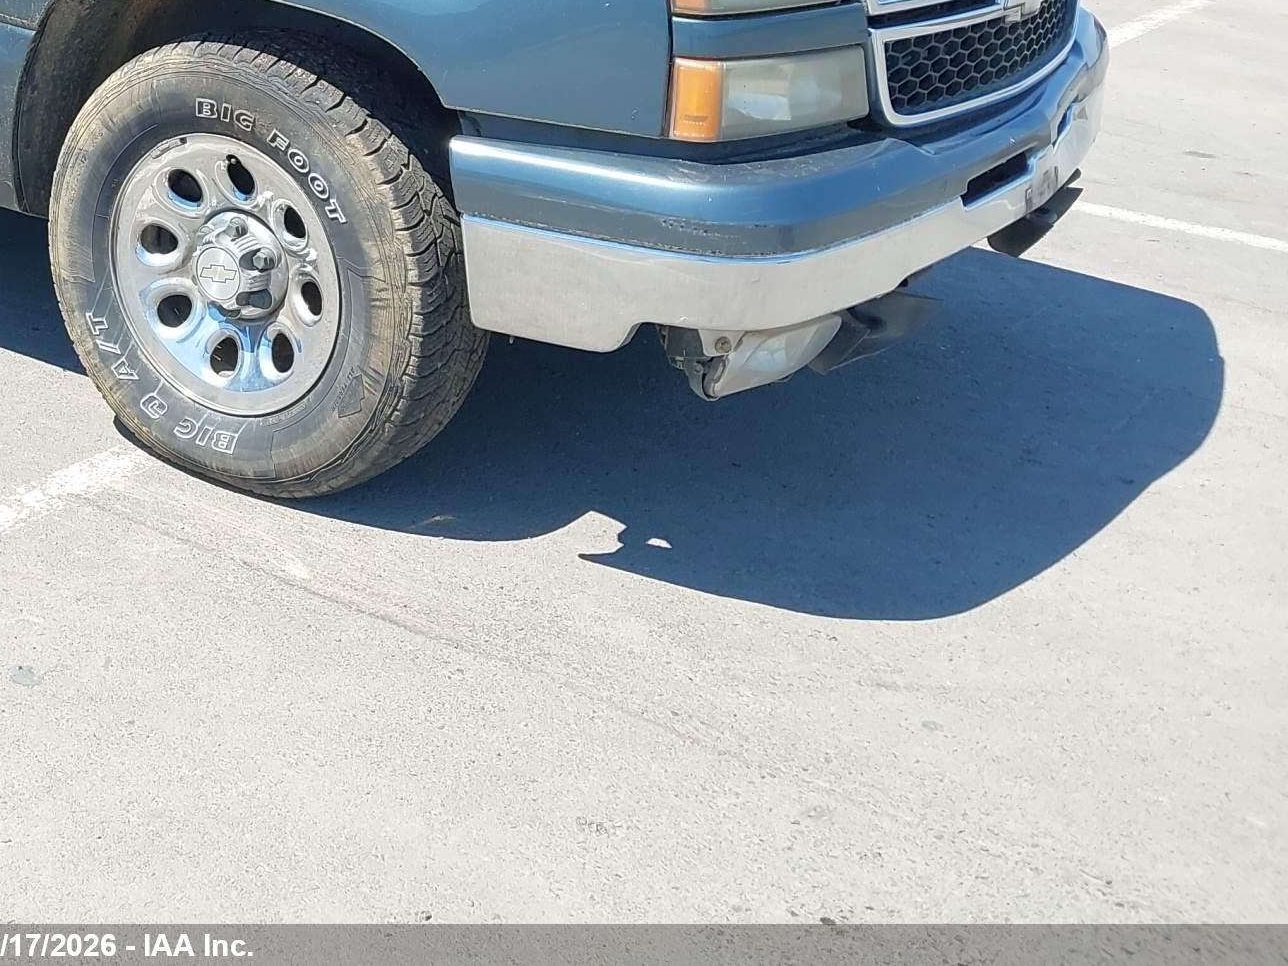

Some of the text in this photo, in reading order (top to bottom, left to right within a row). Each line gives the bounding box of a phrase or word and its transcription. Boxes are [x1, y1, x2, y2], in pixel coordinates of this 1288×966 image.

[195, 97, 347, 224] BIG FOOT
[85, 312, 140, 381] A/T
[173, 417, 240, 455] BIG
